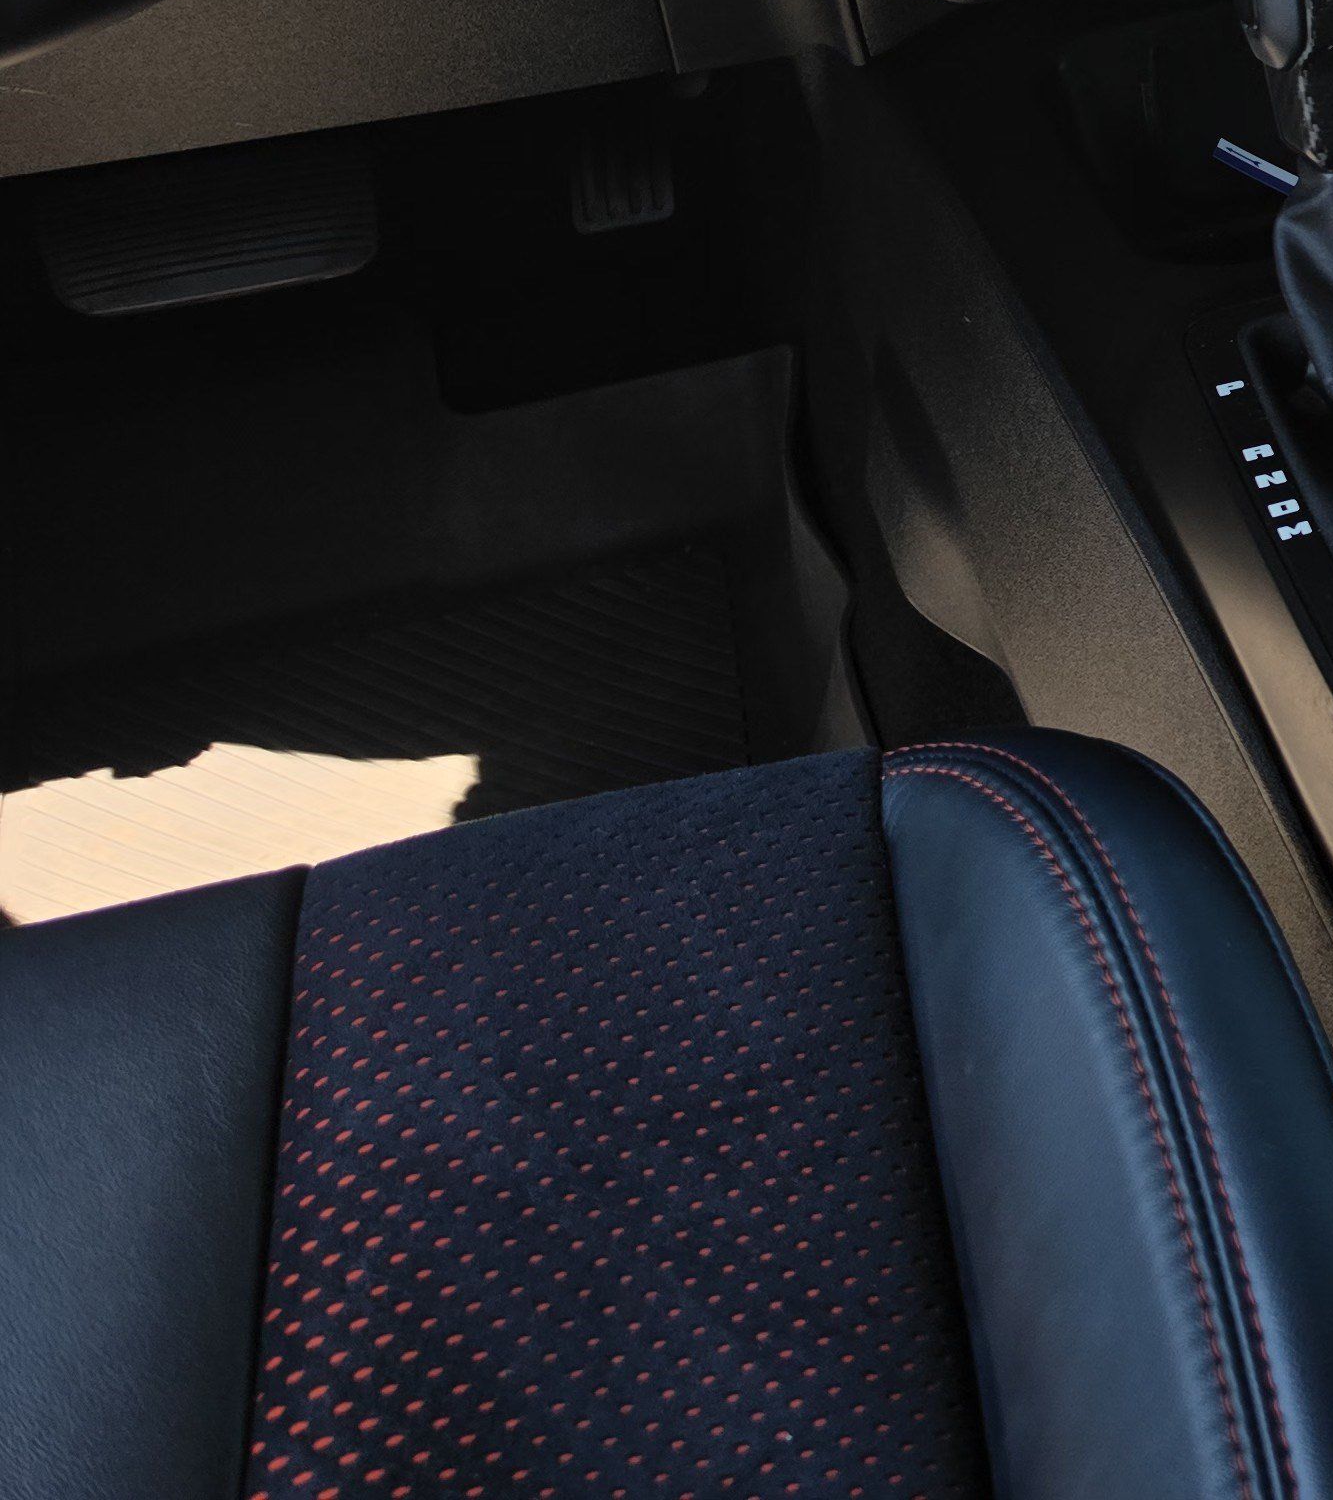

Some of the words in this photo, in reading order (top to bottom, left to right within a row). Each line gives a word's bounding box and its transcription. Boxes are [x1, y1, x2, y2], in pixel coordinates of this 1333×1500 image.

[1216, 380, 1245, 397] P
[1242, 443, 1274, 462] R
[1254, 470, 1287, 489] N
[1277, 520, 1312, 541] M
